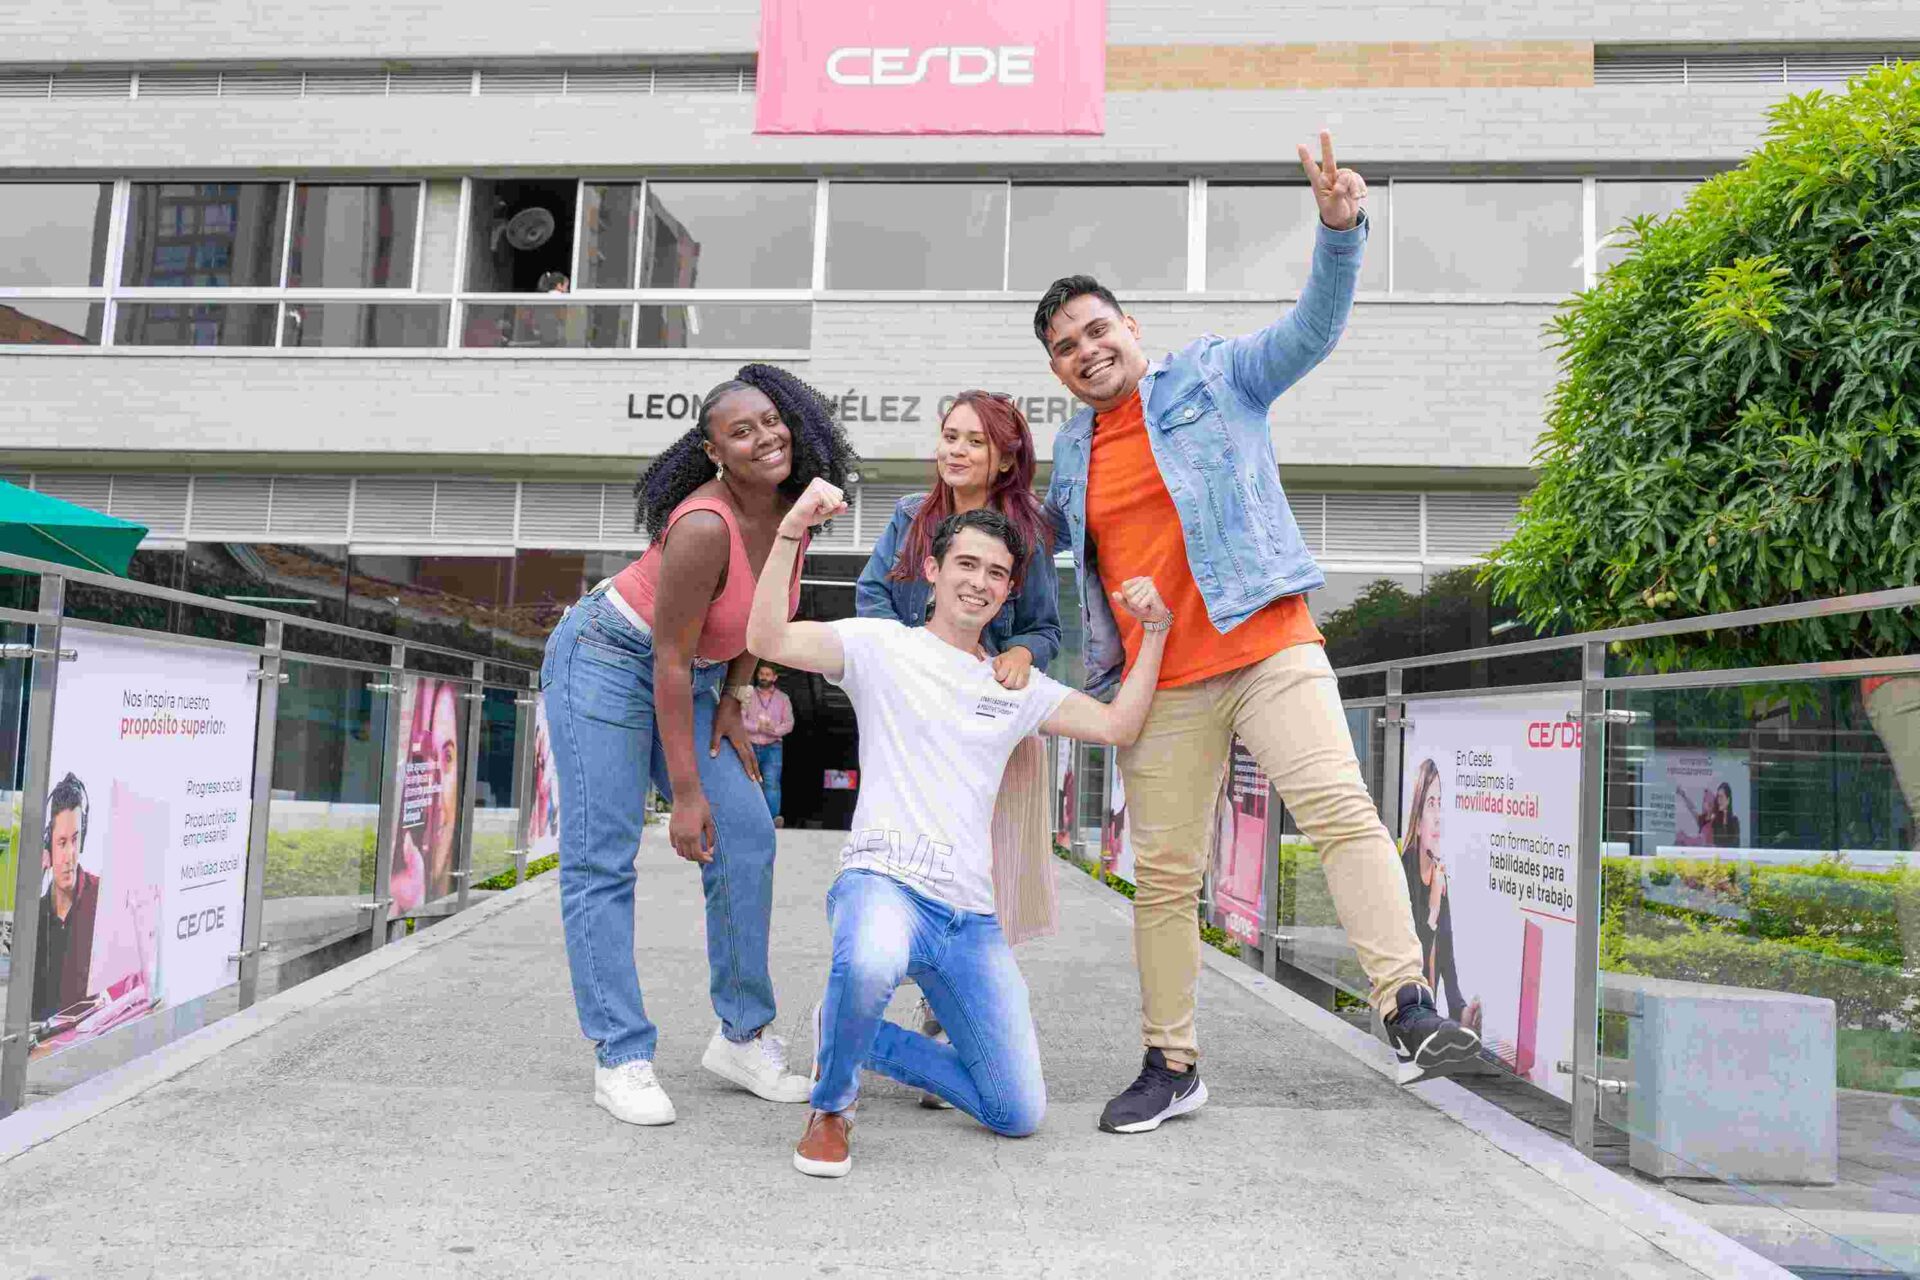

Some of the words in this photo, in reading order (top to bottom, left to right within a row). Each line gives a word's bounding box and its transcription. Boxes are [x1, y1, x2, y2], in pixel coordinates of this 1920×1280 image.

[826, 46, 1035, 85] CESDE
[628, 393, 704, 419] LEON
[834, 388, 920, 422] ÉLEZ
[123, 689, 142, 708] Nos
[144, 689, 175, 712] inspira
[177, 695, 210, 710] nuestro
[120, 712, 178, 740] propósito
[181, 714, 226, 740] superior:
[1456, 750, 1466, 766] En
[1468, 750, 1493, 767] Cesde
[186, 779, 221, 798] Progreso
[222, 776, 243, 793] social
[1455, 768, 1505, 790] impulsamos
[1506, 772, 1514, 790] la
[184, 807, 237, 829] Productividad
[1455, 791, 1504, 814] movilidad
[1506, 794, 1539, 818] social
[183, 827, 228, 848] empresarial
[1490, 833, 1506, 848] con
[1508, 831, 1555, 856] formación
[1557, 843, 1571, 859] en
[180, 858, 218, 880] Movilidad
[219, 854, 240, 872] social
[1489, 850, 1540, 877] habilidades
[1542, 864, 1564, 883] para
[1489, 872, 1497, 890] la
[1498, 875, 1517, 895] vida
[1518, 882, 1525, 902] y
[1526, 881, 1535, 899] el
[1537, 883, 1573, 912] trabajo
[177, 905, 226, 940] CESDE
